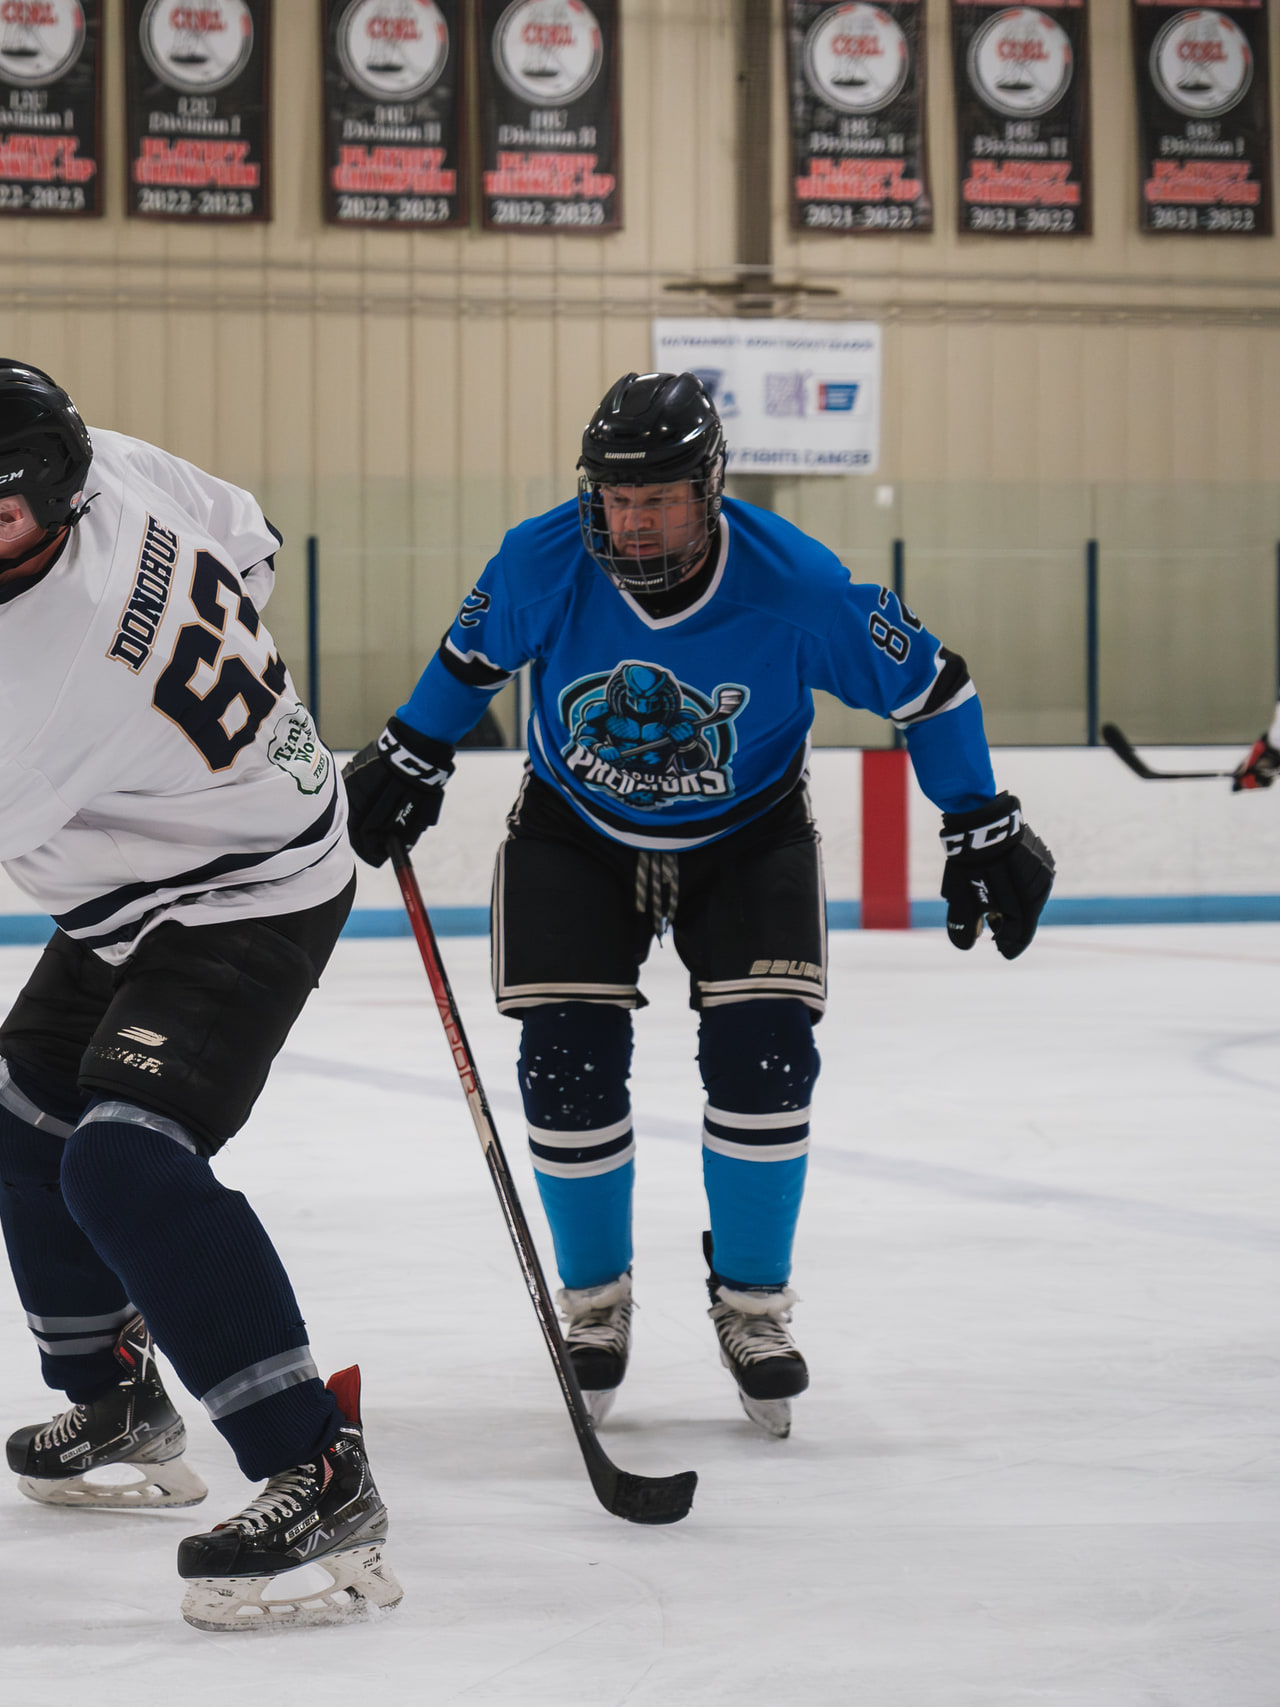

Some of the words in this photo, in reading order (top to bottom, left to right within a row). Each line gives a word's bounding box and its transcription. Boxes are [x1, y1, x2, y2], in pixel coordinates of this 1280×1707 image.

[149, 112, 228, 134] Division
[106, 512, 179, 675] DONOHUE
[868, 586, 924, 664] 82
[566, 742, 727, 795] PREDORS
[62, 1443, 89, 1461] BAUER
[288, 1514, 317, 1539] BAUER
